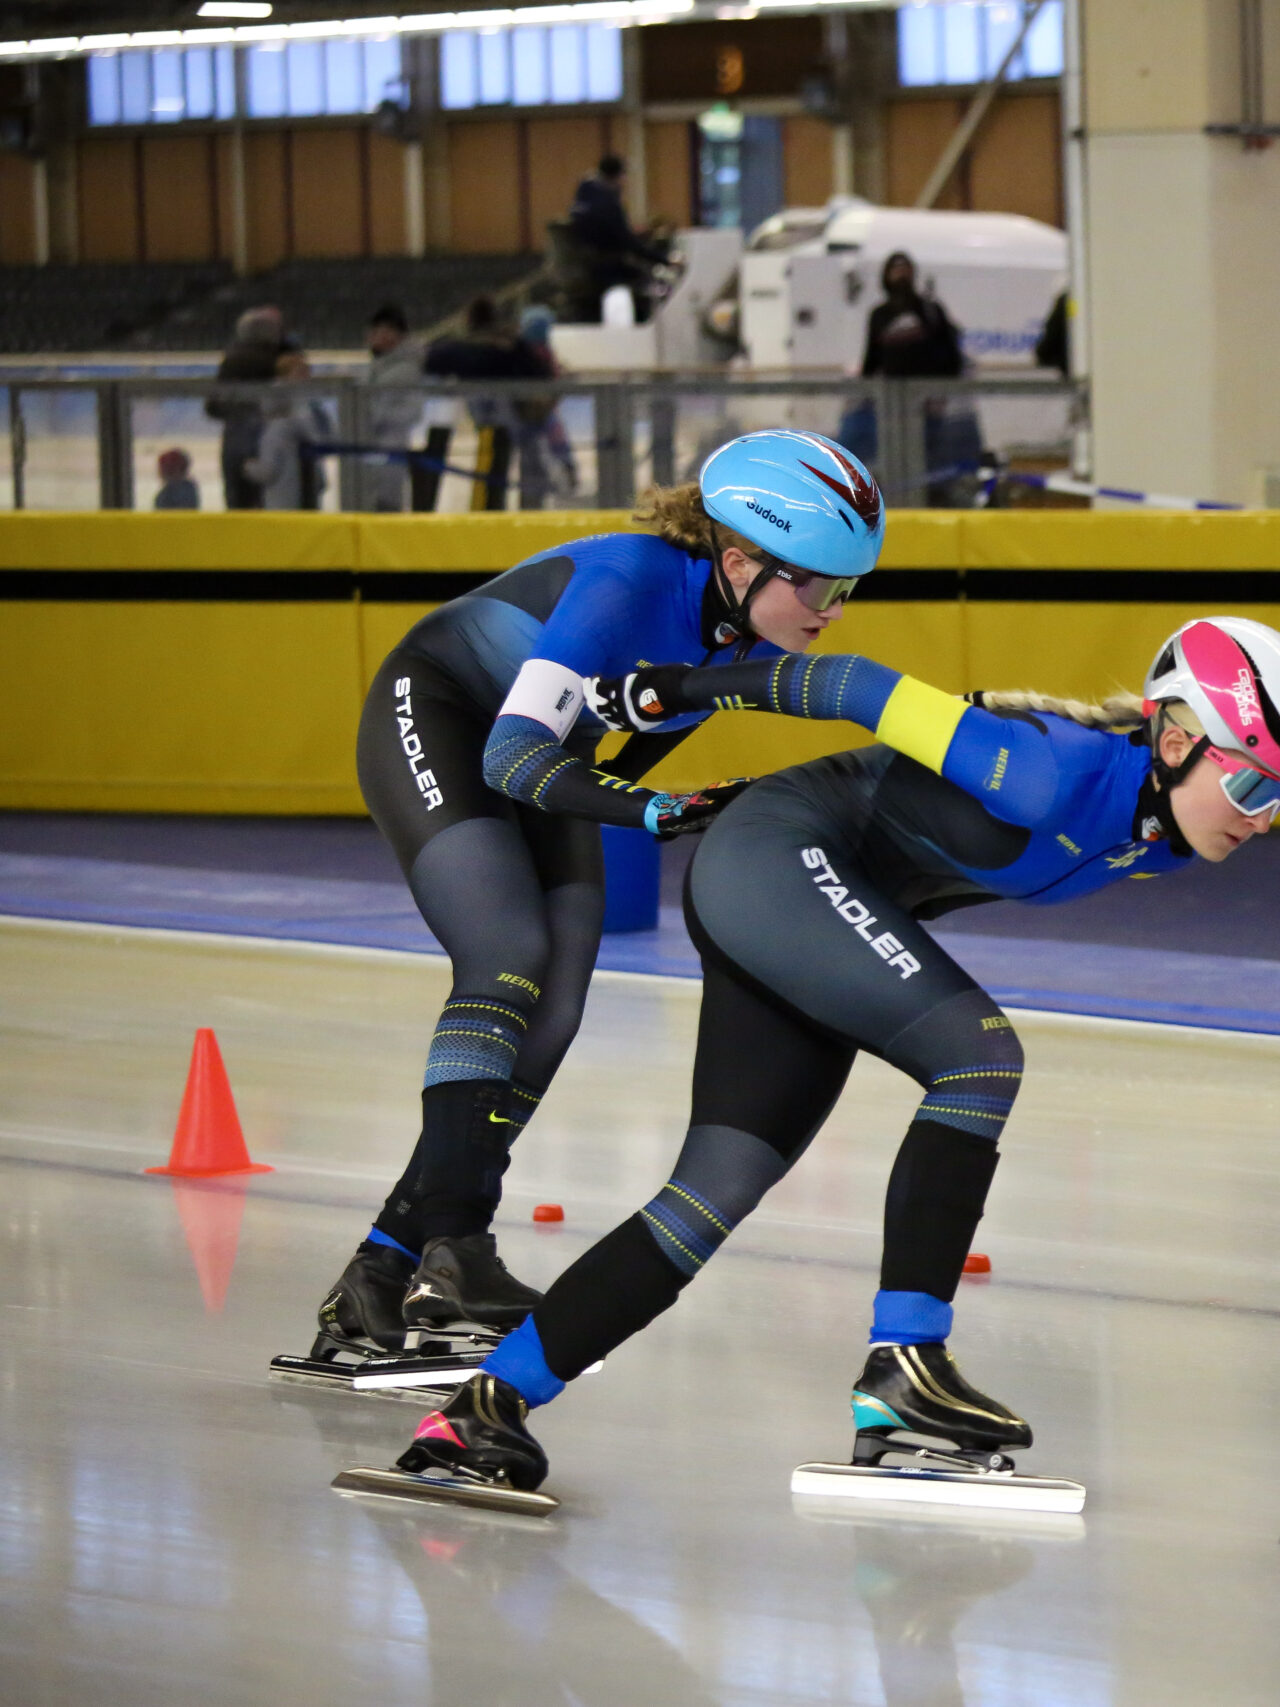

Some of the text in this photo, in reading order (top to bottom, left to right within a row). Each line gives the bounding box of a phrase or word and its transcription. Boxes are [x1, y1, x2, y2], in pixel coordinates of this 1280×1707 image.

[746, 498, 792, 533] Gudook
[395, 676, 444, 812] STADLER
[801, 847, 922, 980] STADLER
